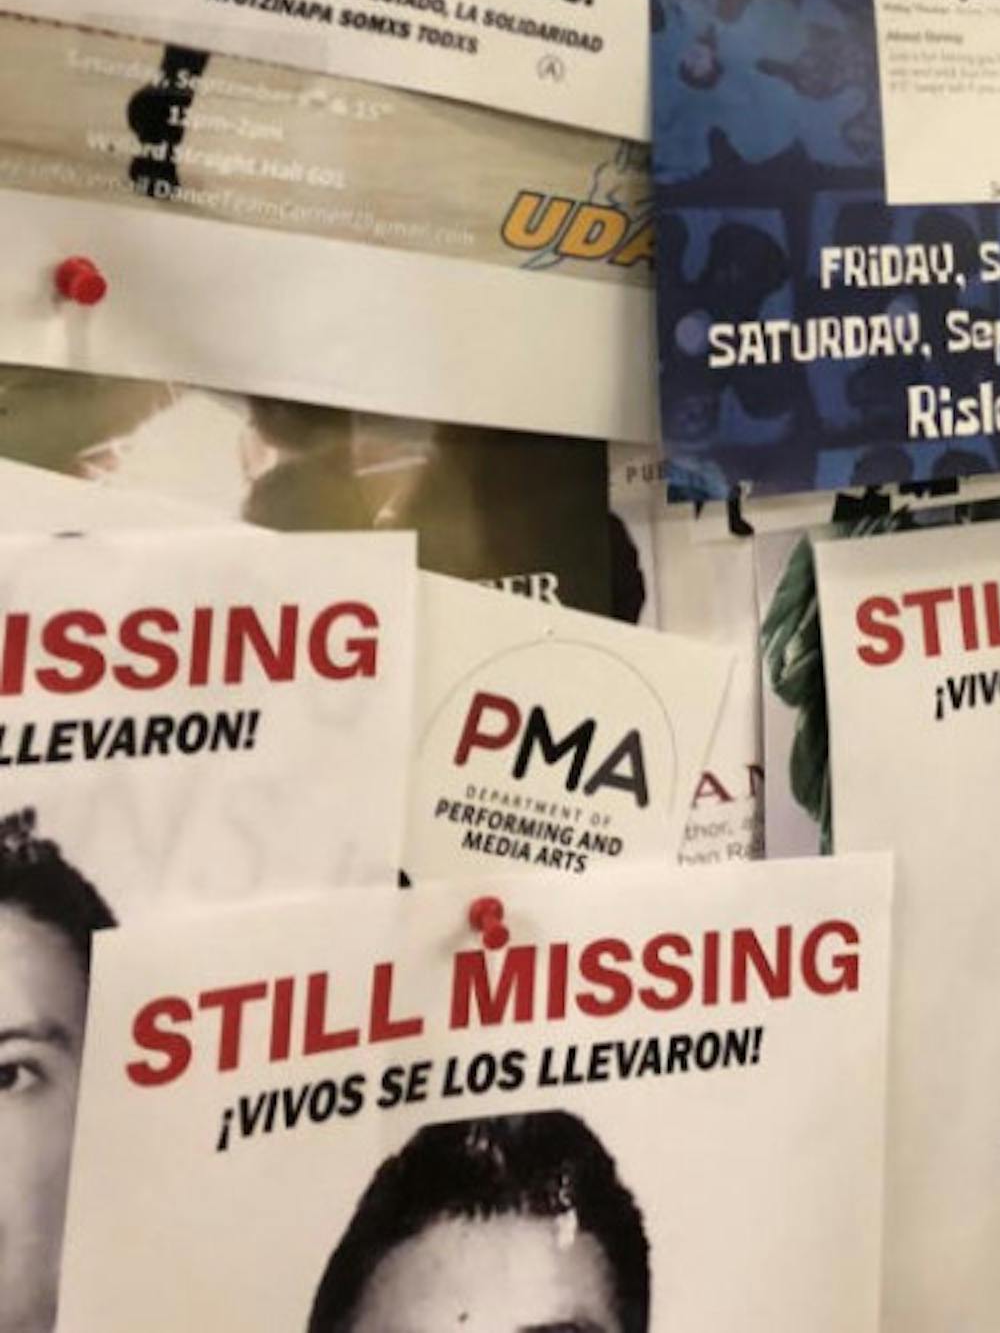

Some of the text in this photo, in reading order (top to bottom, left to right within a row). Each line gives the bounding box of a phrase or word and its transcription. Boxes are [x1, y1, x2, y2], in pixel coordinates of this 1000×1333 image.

[337, 6, 414, 43] SOMXS
[416, 23, 481, 57] TODXS
[482, 5, 606, 55] SOLIDARIDAD
[706, 314, 934, 370] SATURDAY,
[453, 690, 651, 809] PMA
[434, 797, 624, 858] PERFORMING AND
[465, 783, 612, 829] DEPARTMENT OF
[461, 829, 589, 874] MEDIA ARTS
[125, 918, 862, 1090] STILL MISSING
[216, 1025, 764, 1153] ¡VIVOS SE LOS LLEVARON!
